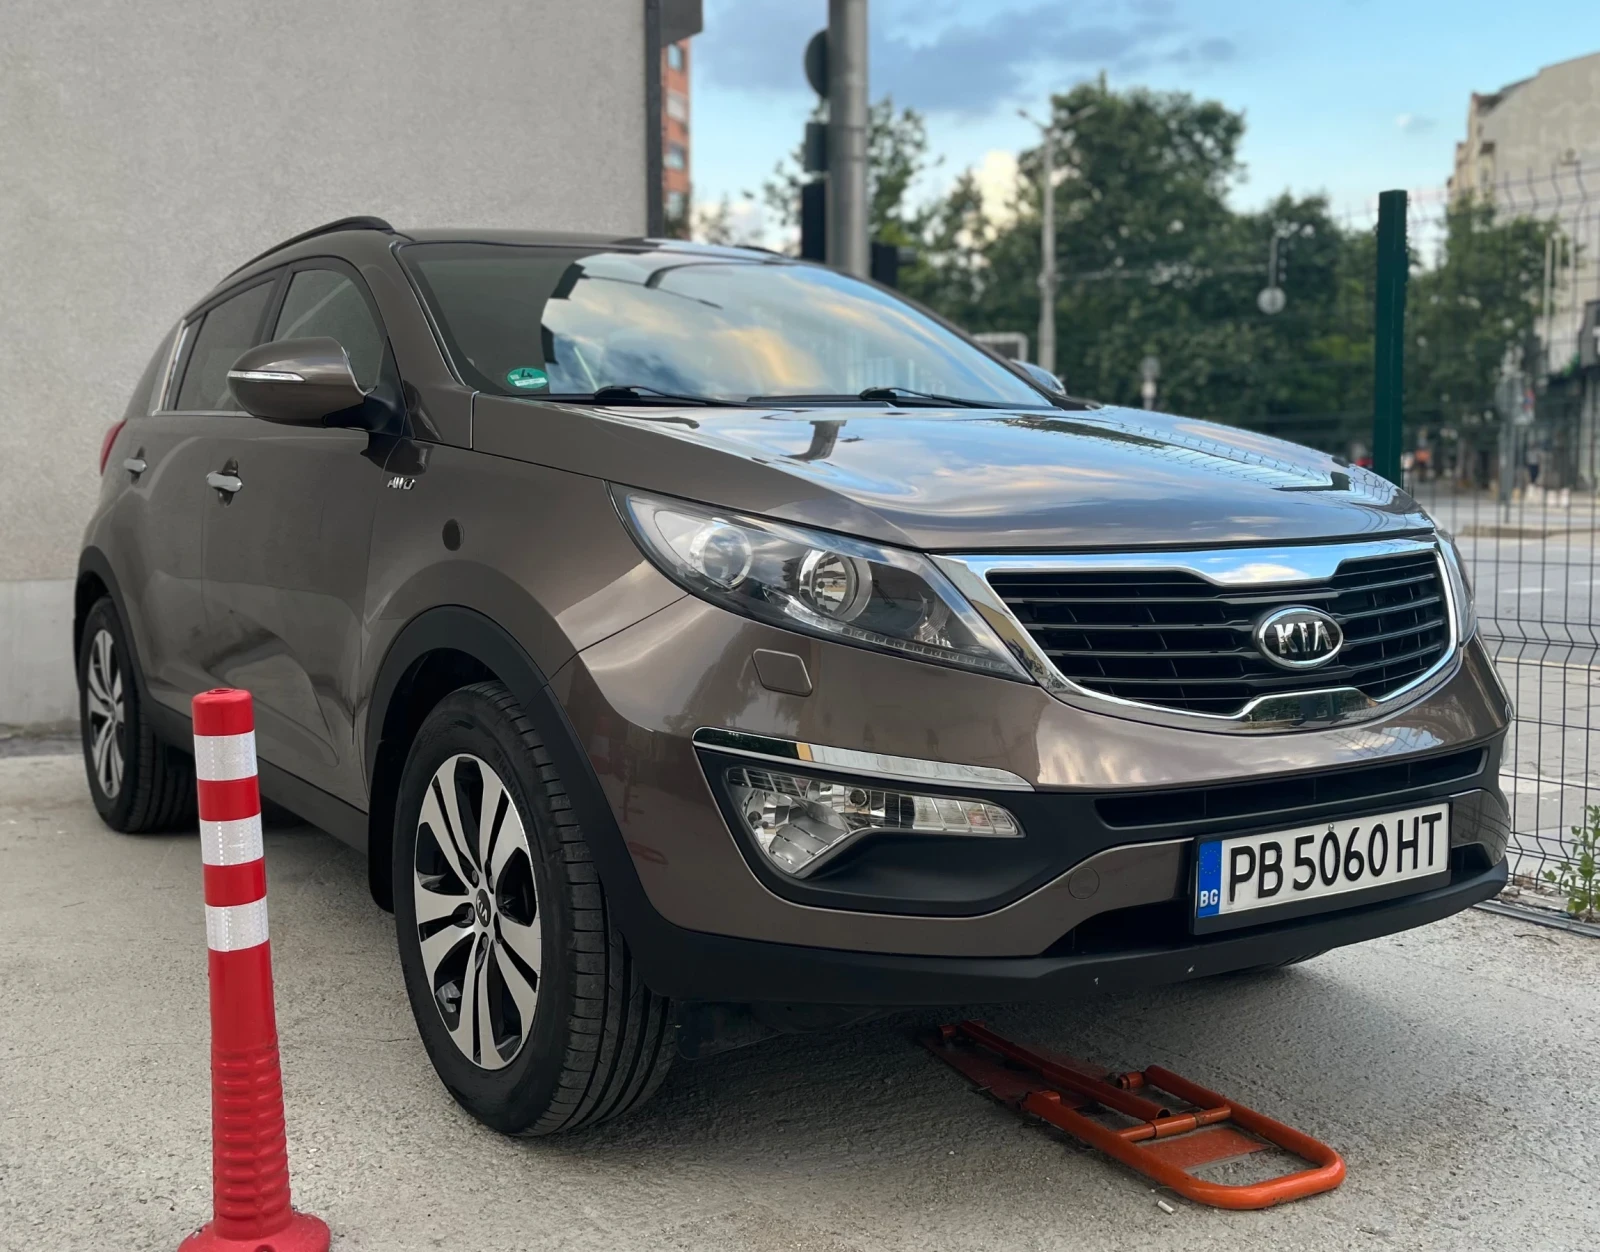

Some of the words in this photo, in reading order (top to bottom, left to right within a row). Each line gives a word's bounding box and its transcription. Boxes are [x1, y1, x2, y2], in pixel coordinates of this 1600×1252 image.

[1274, 621, 1333, 654] KIA
[1229, 841, 1284, 902] PB
[1292, 823, 1389, 891] 5060
[1396, 811, 1443, 873] HT
[476, 895, 488, 922] KIA
[1200, 889, 1219, 908] BG
